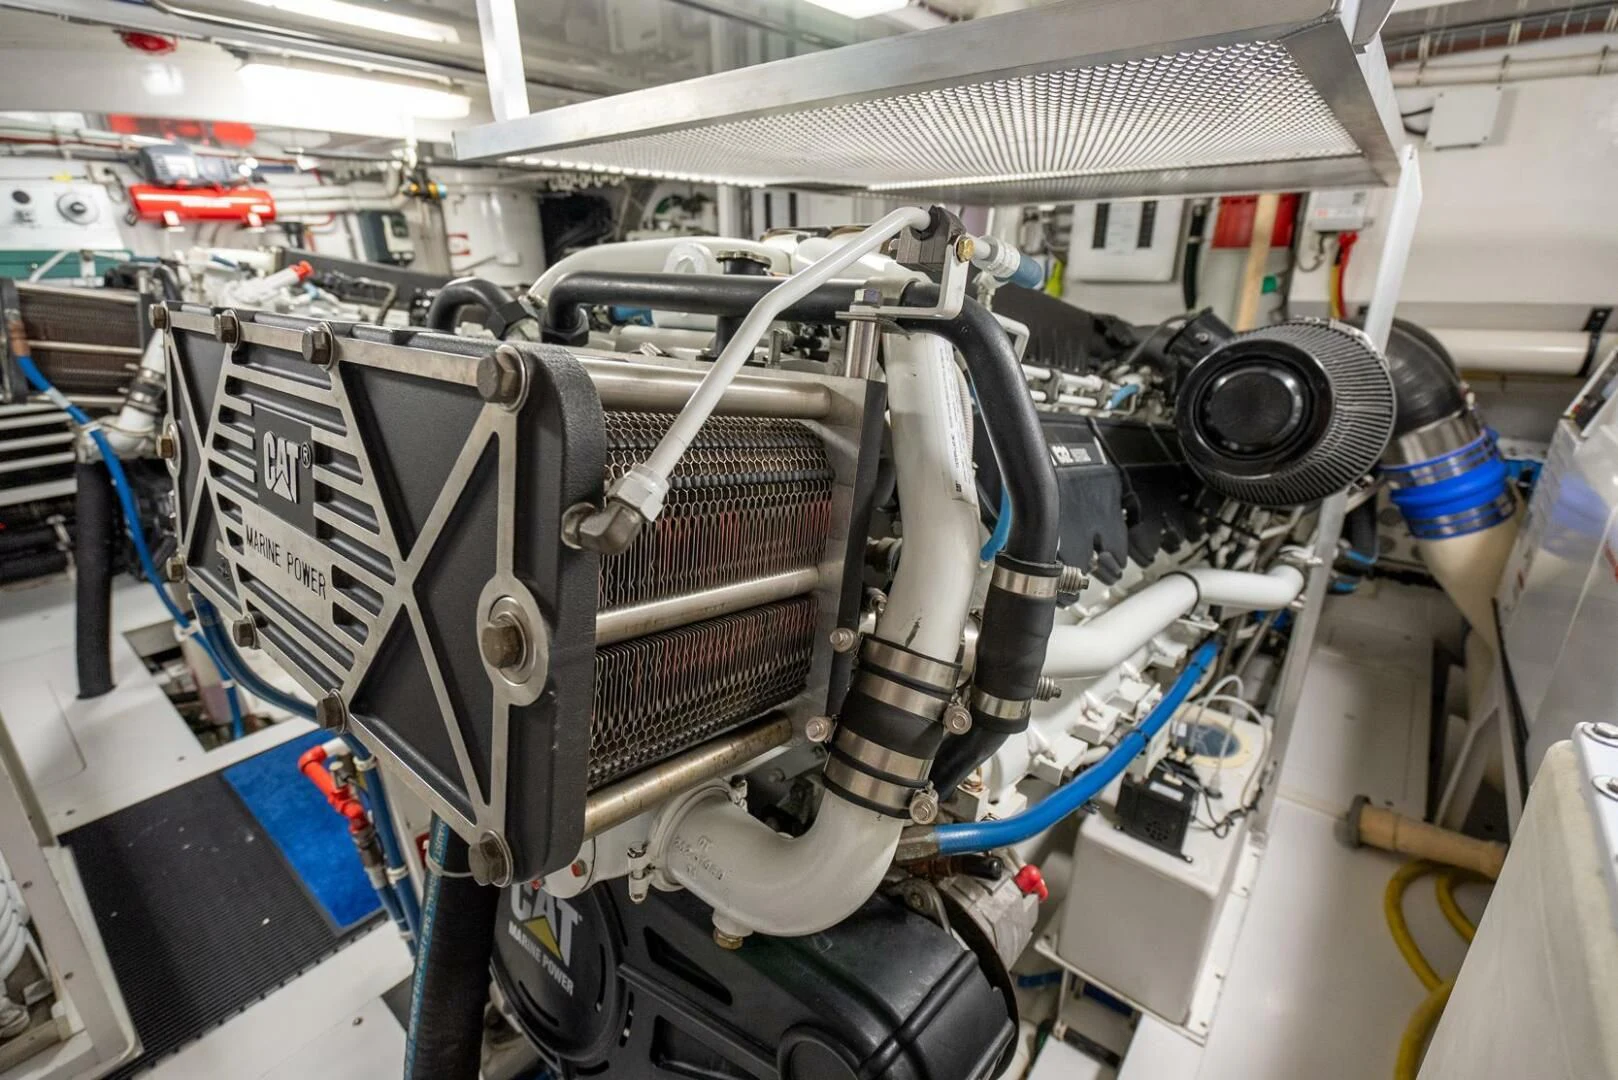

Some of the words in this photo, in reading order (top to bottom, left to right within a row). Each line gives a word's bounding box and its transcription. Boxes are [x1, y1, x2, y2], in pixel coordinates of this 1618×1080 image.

[246, 524, 281, 569] MARINE
[287, 552, 327, 601] POWER
[508, 920, 542, 963] MARINE
[542, 953, 574, 997] POWER
[511, 882, 579, 969] CAT
